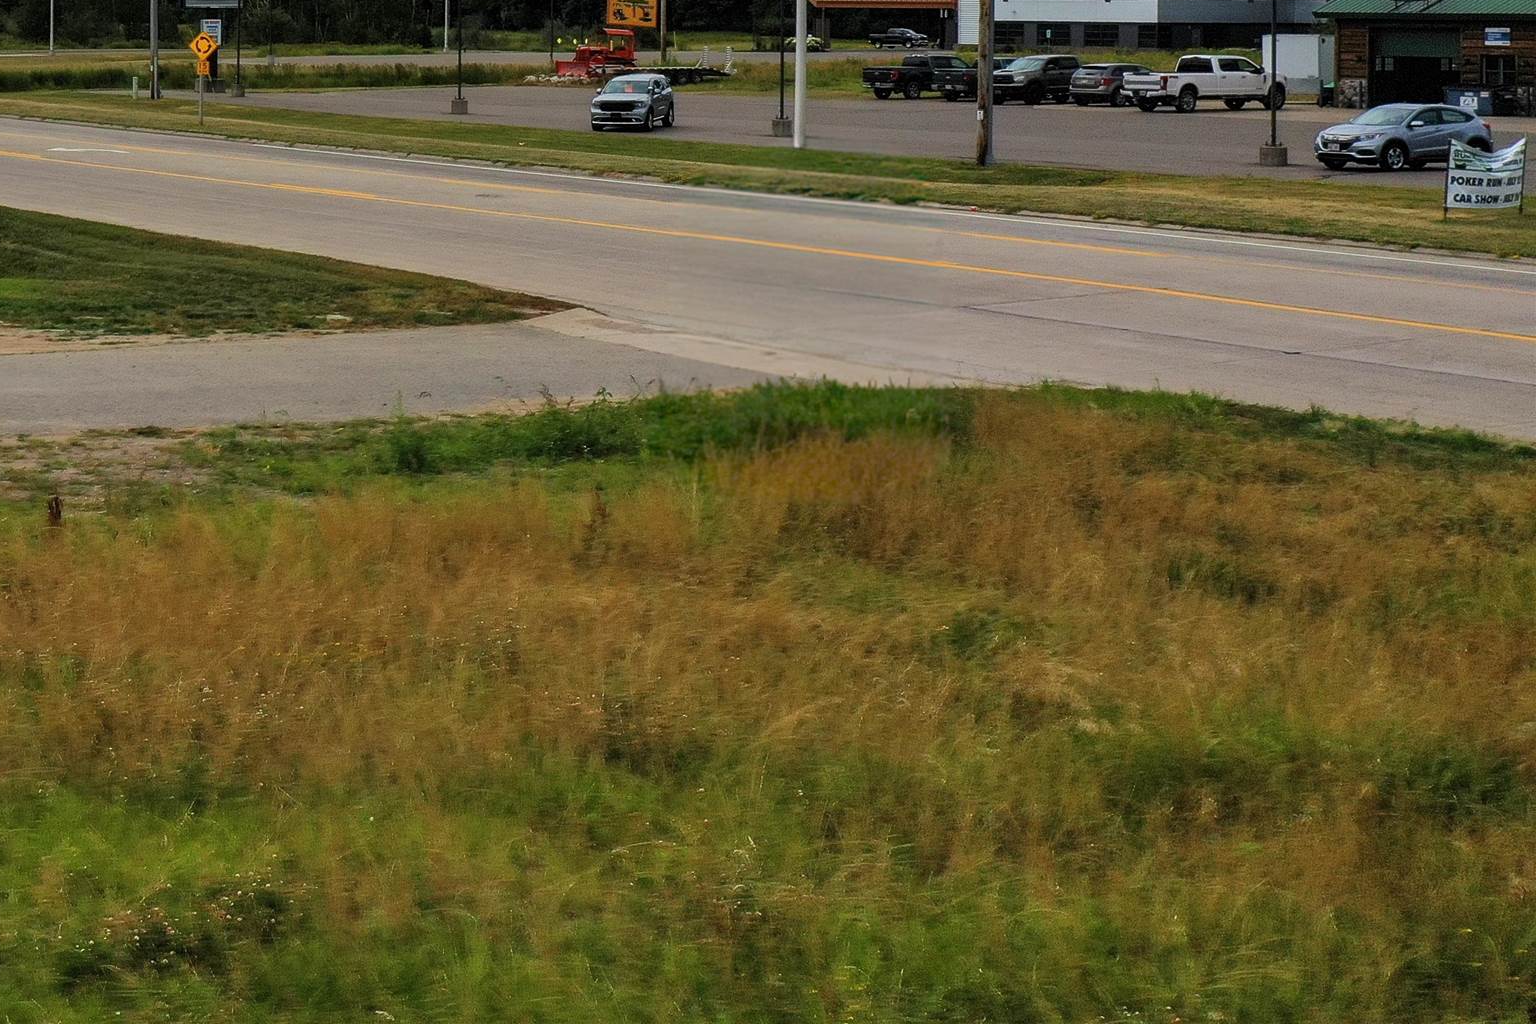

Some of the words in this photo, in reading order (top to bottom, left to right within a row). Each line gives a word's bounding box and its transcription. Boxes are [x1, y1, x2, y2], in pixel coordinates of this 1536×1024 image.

[1450, 176, 1484, 187] POKER
[1486, 177, 1503, 187] RUN
[1453, 194, 1472, 203] CAR
[1474, 195, 1500, 204] SHOW
